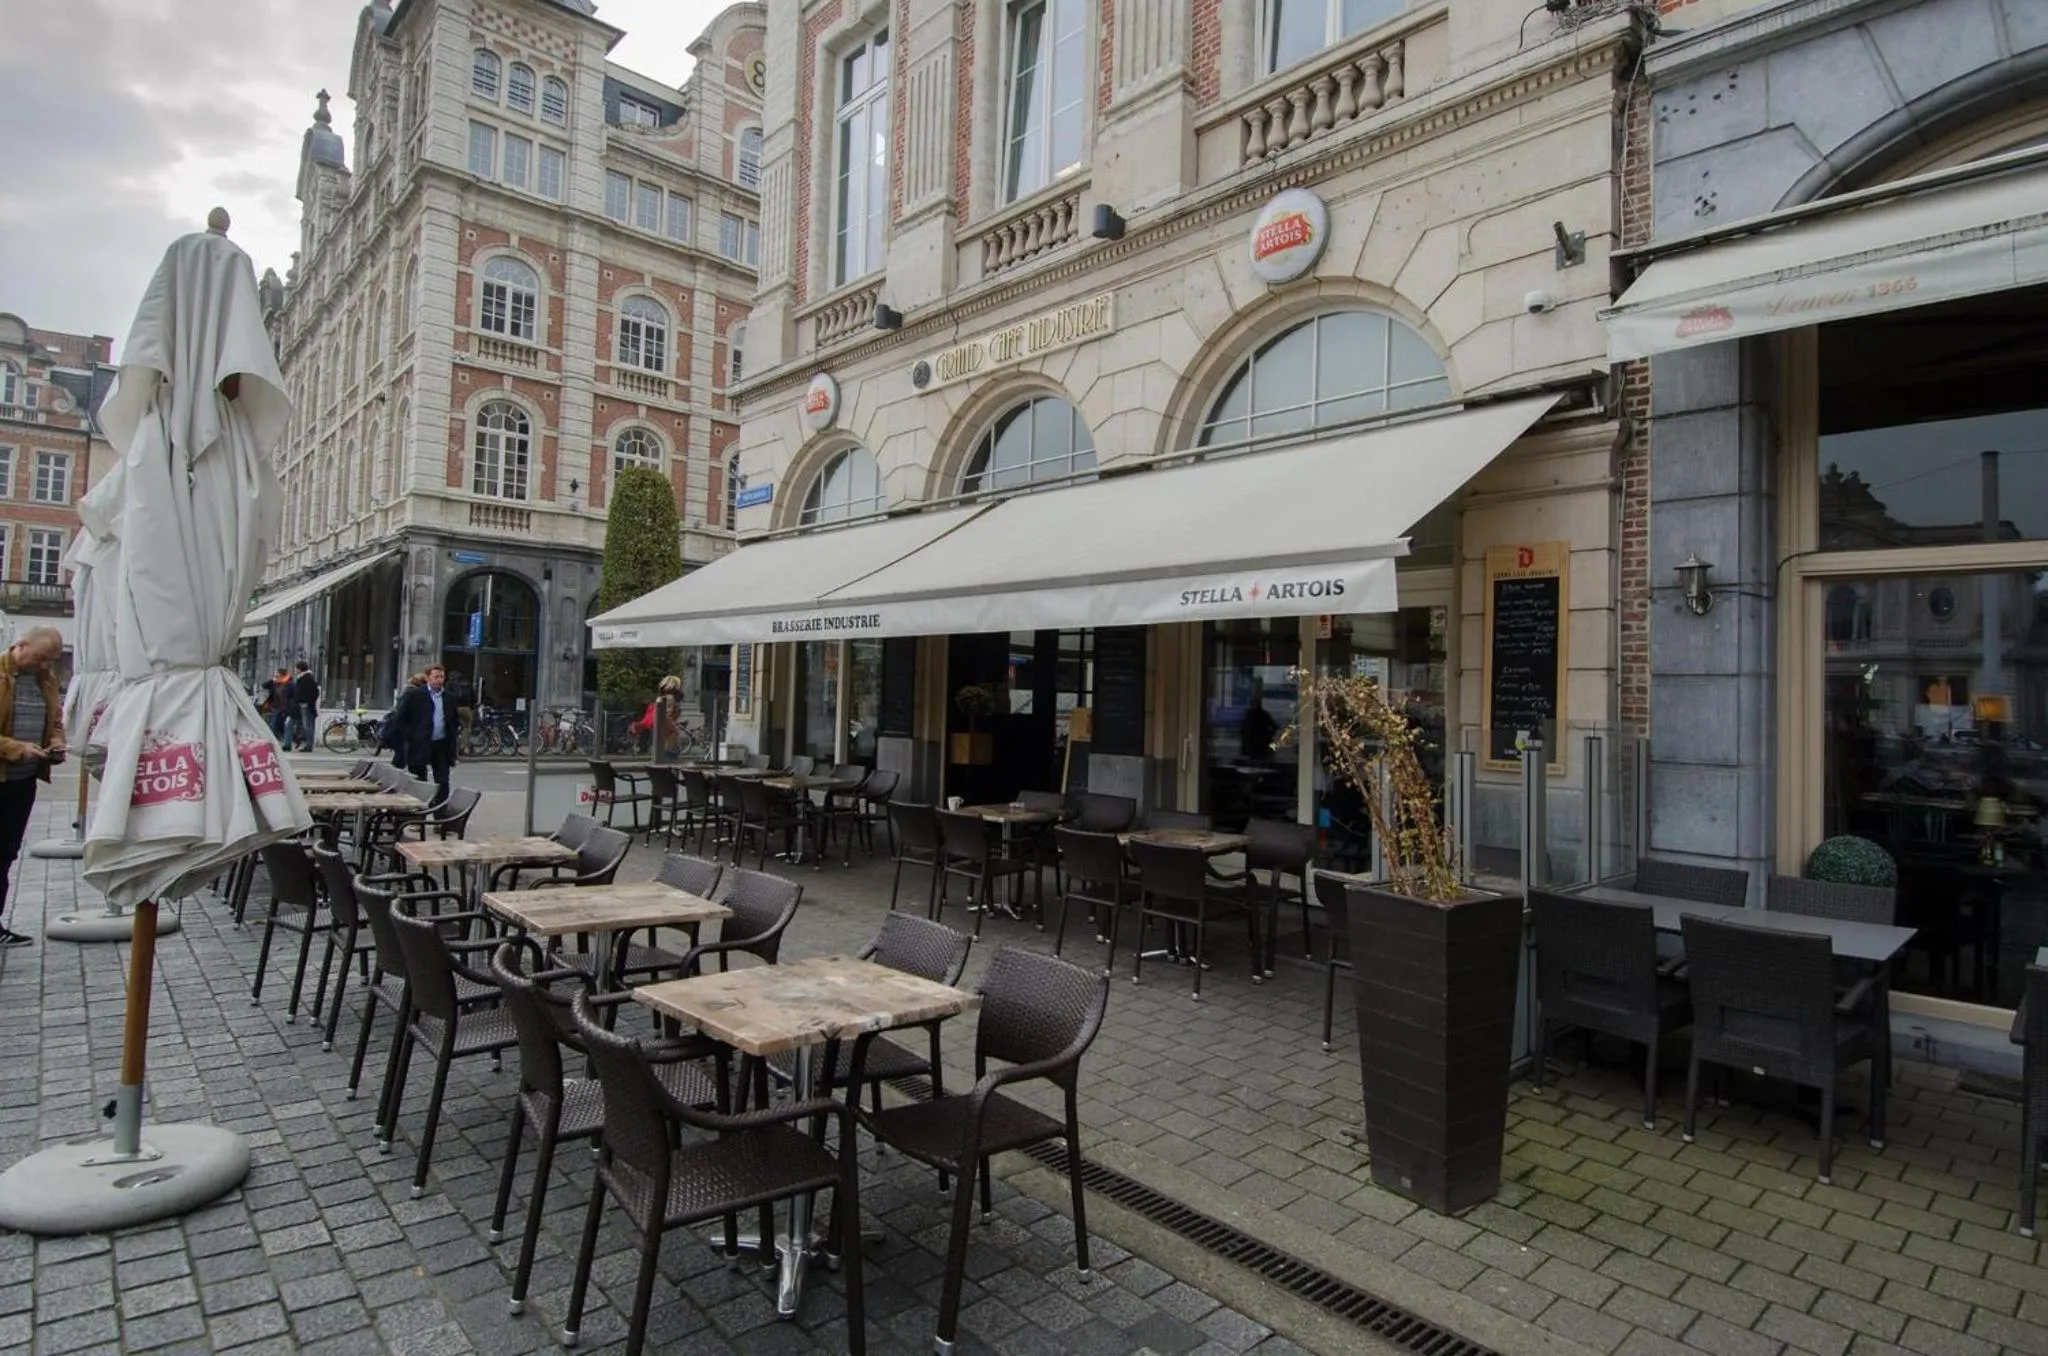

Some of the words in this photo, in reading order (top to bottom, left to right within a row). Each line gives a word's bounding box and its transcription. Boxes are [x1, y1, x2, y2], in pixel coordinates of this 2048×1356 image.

[1260, 219, 1301, 241] STELLA
[1260, 230, 1301, 251] ARTOIS
[935, 343, 984, 382] GRAND
[1027, 295, 1110, 354] INDUSTRIE
[1180, 586, 1243, 606] STELLA
[1266, 578, 1345, 600] ARTOIS
[772, 618, 823, 633] BRASSERIE
[824, 613, 880, 631] INDUSTRIE
[134, 771, 189, 795] TOIS
